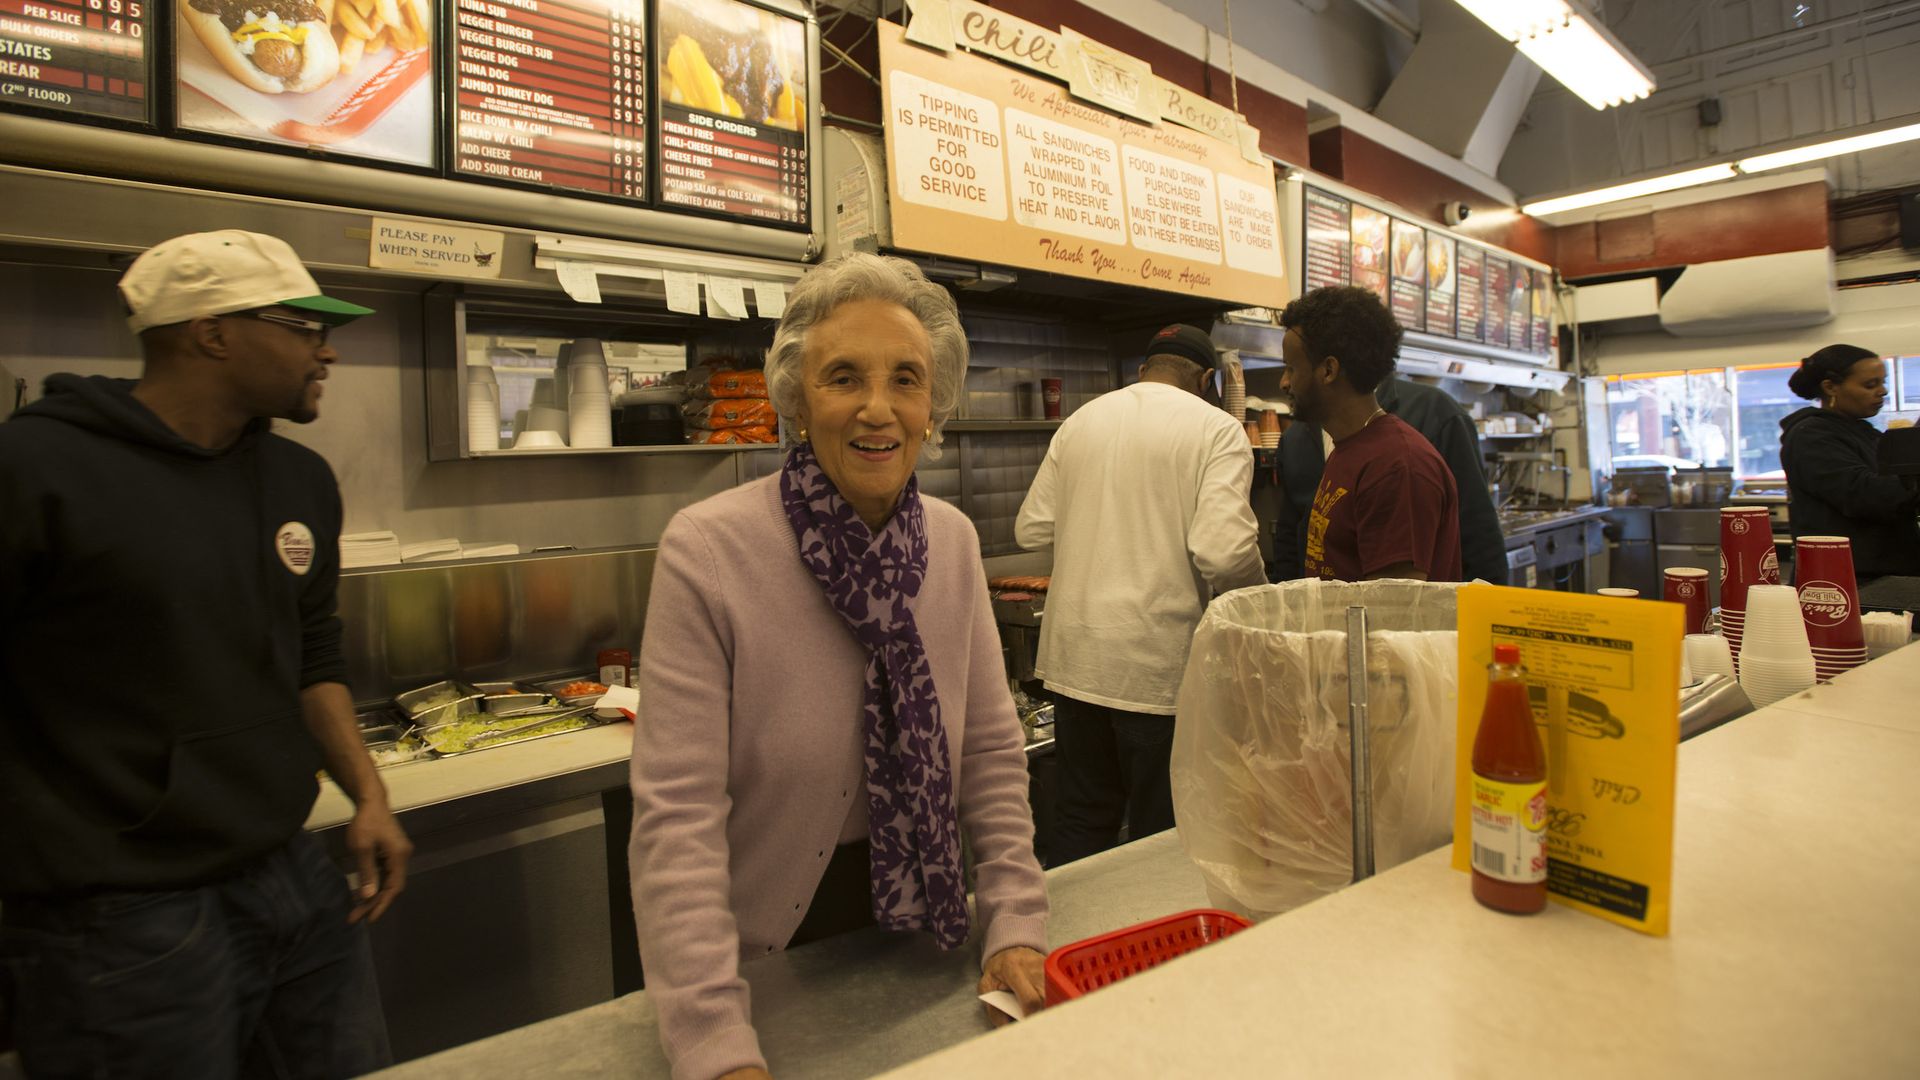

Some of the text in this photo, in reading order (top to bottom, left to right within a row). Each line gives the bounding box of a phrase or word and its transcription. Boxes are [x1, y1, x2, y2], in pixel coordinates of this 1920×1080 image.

[24, 4, 48, 19] PER
[50, 9, 81, 25] SLICE
[460, 0, 486, 13] TUNA
[487, 4, 507, 18] SUB
[33, 25, 80, 43] ORDERS
[460, 13, 494, 31] VEGGIE
[495, 22, 533, 40] BURGER
[0, 39, 52, 60] STATES
[460, 29, 494, 46] VEGGIE
[496, 38, 533, 55] BURGER
[535, 47, 553, 60] SUB
[963, 11, 1058, 69] Chili
[462, 45, 496, 62] VEGGIE
[498, 53, 518, 67] DOG
[0, 60, 40, 80] REAR
[460, 61, 487, 76] TUNA
[489, 67, 510, 81] DOG
[28, 87, 72, 104] FLOOR)
[460, 77, 494, 94] JUMBO
[497, 84, 532, 102] TURKEY
[534, 92, 554, 106] DOG
[920, 94, 978, 124] TIPPING
[1010, 79, 1035, 103] We
[1041, 92, 1111, 129] Appreciate
[1153, 127, 1208, 160] Patronage
[461, 110, 482, 123] RICE
[484, 114, 512, 129] BOWL
[514, 120, 528, 132] W/
[530, 123, 553, 136] CHILI
[665, 121, 693, 136] FRENCH
[694, 126, 714, 140] FRIES
[689, 113, 757, 136] SIDE ORDERS
[899, 108, 999, 148] IS PERMITTED
[461, 143, 479, 155] ADD
[481, 146, 511, 160] CHEESE
[495, 132, 509, 144] W/
[511, 135, 533, 148] CHILI
[665, 136, 713, 154] CHILI-CHEESE
[714, 146, 734, 158] FRIES
[937, 138, 967, 158] FOR
[1016, 123, 1111, 162] ALL SANDWICHES
[461, 160, 482, 171] ADD
[484, 162, 509, 176] SOUR
[512, 167, 543, 180] CREAM
[665, 150, 693, 165] CHEESE
[694, 155, 713, 167] FRIES
[930, 156, 976, 180] GOOD
[1031, 146, 1101, 176] WRAPPED IN
[665, 164, 684, 175] CHILI
[686, 168, 705, 180] FRIES
[1024, 161, 1113, 196] ALUMINIUM FOIL
[1129, 156, 1207, 189] FOOD AND DRINK
[665, 178, 693, 191] POTATO
[694, 183, 716, 195] SALAD
[727, 188, 744, 199] COLE
[745, 192, 763, 203] SLAW
[921, 175, 987, 202] SERVICE
[1029, 181, 1109, 211] TO PRESERVE
[1145, 177, 1200, 202] PURCHASED
[1239, 189, 1255, 203] OUR
[665, 192, 702, 206] ASSORTED
[704, 199, 726, 210] CAKES
[1147, 193, 1202, 218] ELSEWHERE
[1224, 199, 1274, 224] SANDWICHES
[1019, 197, 1121, 231] HEAT AND FLAVOR
[1131, 206, 1219, 236] MUST NOT BE EATEN
[380, 227, 456, 246] PLEASE PAY
[1132, 222, 1221, 253] ON THESE PREMISES
[1228, 216, 1273, 236] ARE MADE
[1229, 229, 1273, 250] TO ORDER
[379, 243, 471, 264] WHEN SERVED
[1039, 238, 1084, 264] Thank
[1141, 257, 1172, 280] Come
[1178, 266, 1211, 289] Again
[1803, 591, 1842, 601] Chili Bowl
[1804, 604, 1848, 619] Ben's
[1592, 777, 1641, 805] Chili
